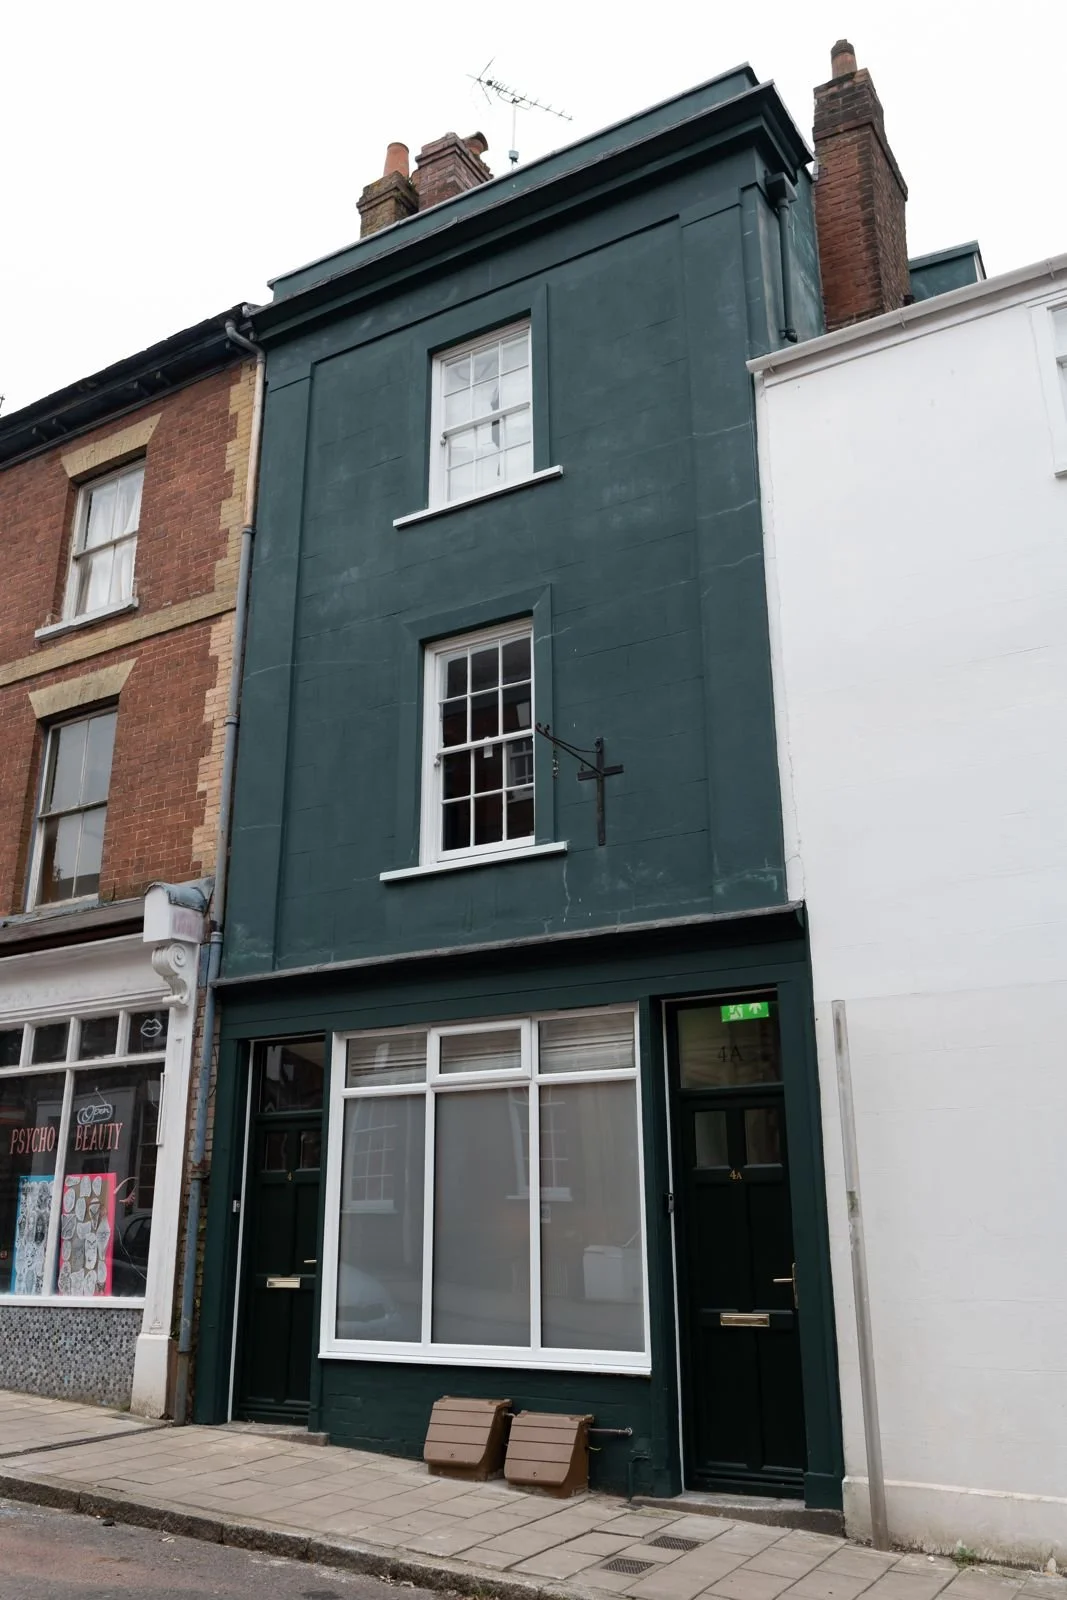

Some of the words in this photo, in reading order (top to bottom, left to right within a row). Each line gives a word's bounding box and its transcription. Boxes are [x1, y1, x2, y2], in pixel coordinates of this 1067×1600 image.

[718, 1046, 743, 1062] 4A
[81, 1105, 110, 1123] Open
[10, 1126, 56, 1155] PSYCHO
[75, 1123, 123, 1151] BEAUTY
[287, 1171, 293, 1181] 4
